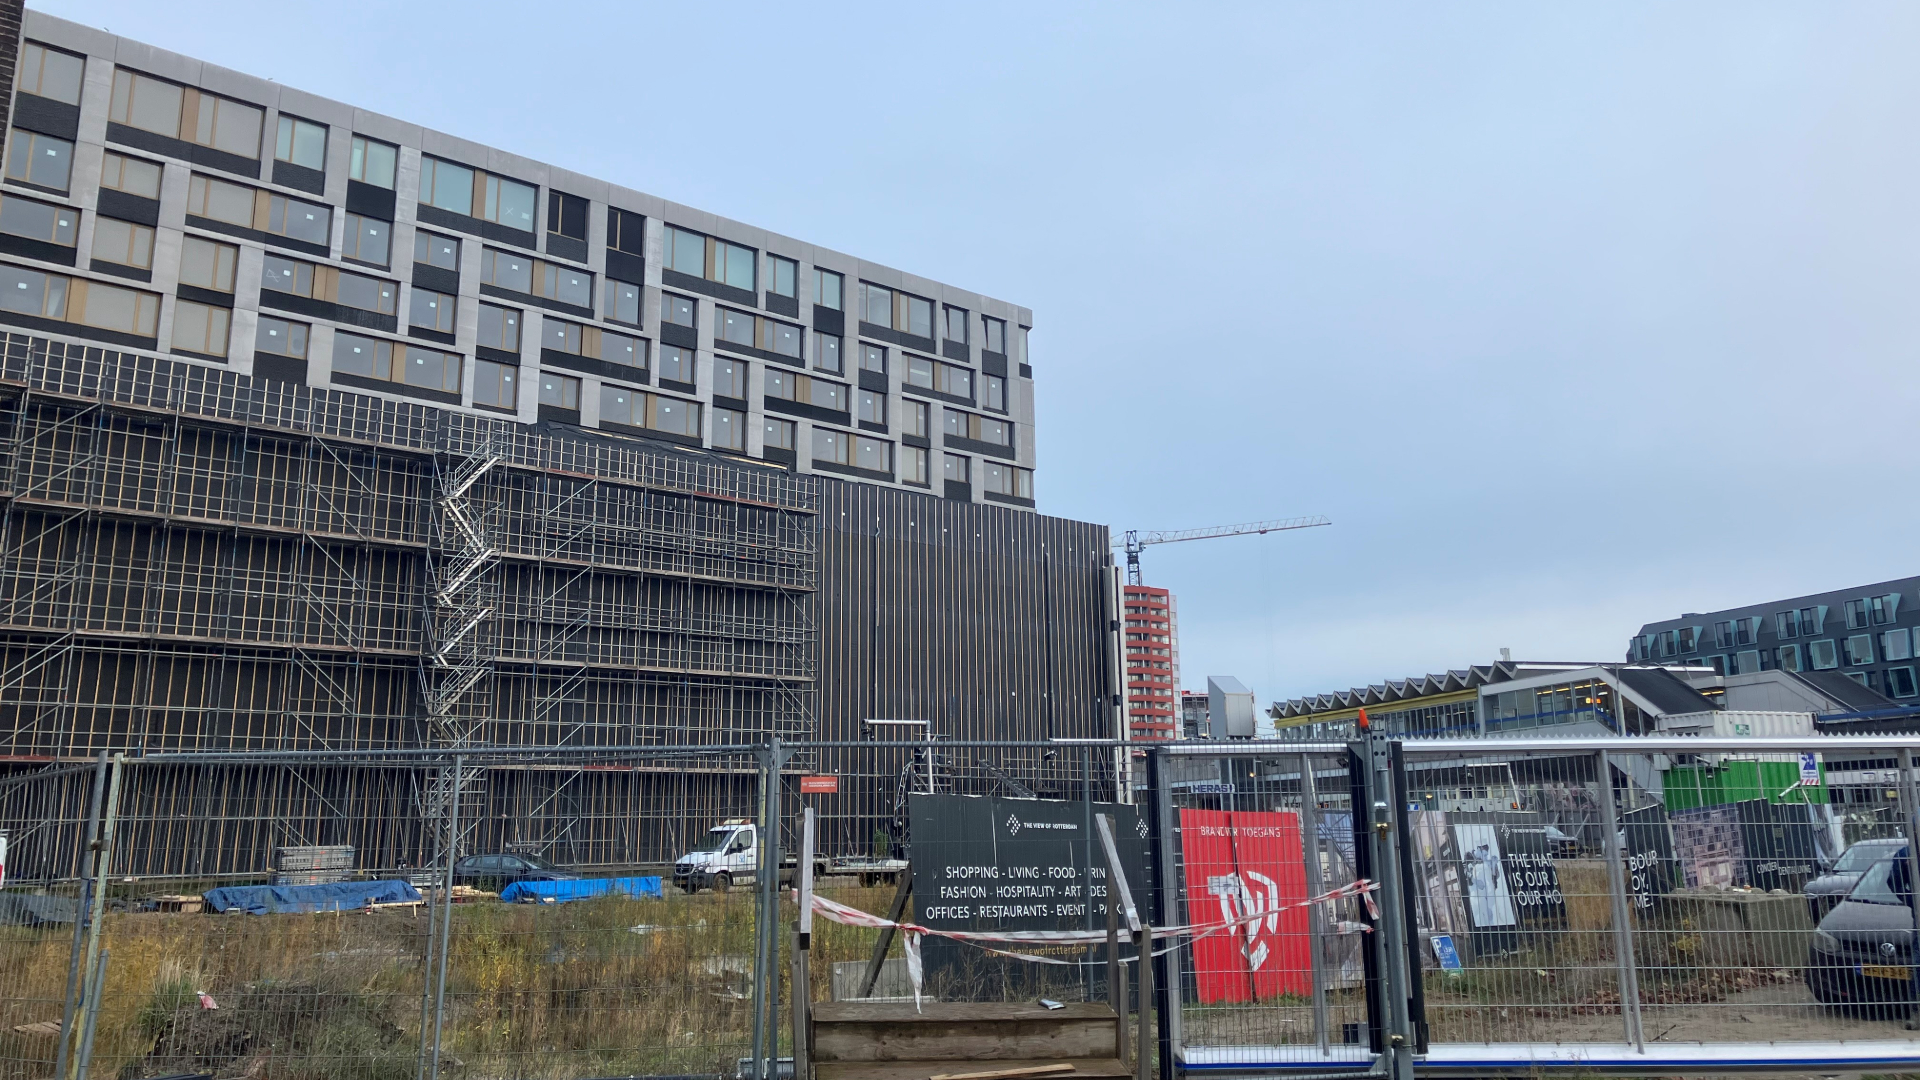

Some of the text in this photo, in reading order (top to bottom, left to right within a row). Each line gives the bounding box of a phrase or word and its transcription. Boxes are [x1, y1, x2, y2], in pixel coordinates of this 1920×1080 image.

[1242, 827, 1281, 838] TOEGANG
[1507, 853, 1556, 868] THE HAR
[1630, 850, 1659, 872] BOUR
[945, 866, 999, 879] SHOPPING
[1008, 866, 1040, 879] LIVING
[1048, 867, 1076, 879] FOOD
[1512, 872, 1524, 887] IS
[1525, 871, 1551, 887] OUR
[940, 886, 987, 899] FASHION
[996, 886, 1056, 898] HOSPITALITY
[1064, 886, 1082, 898] ART
[1517, 889, 1562, 906] OUR HO
[926, 906, 970, 919] OFFICES
[980, 905, 1048, 918] RESTAURANTS
